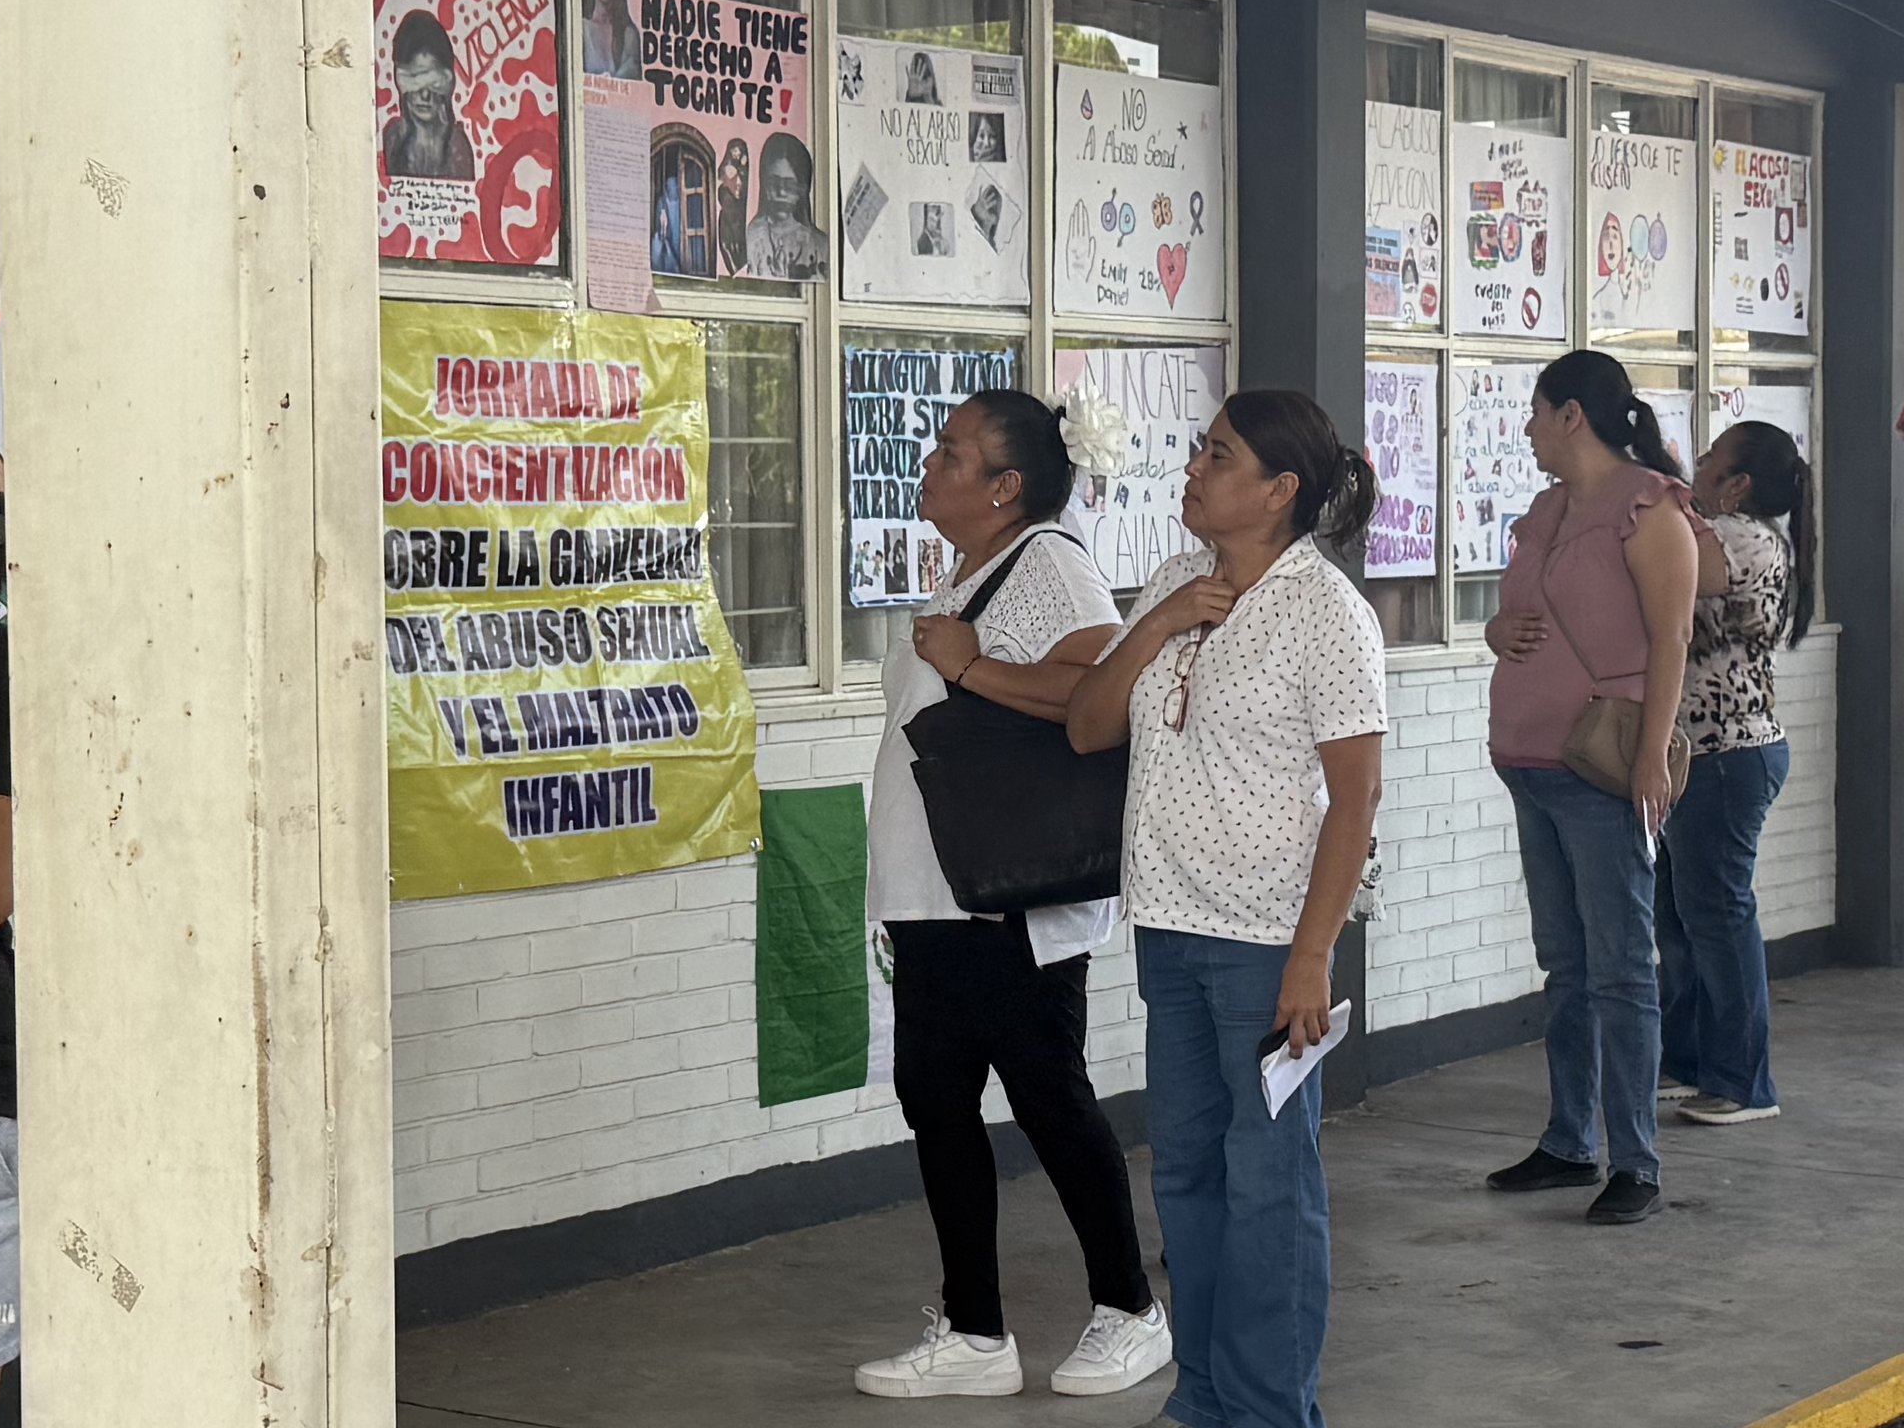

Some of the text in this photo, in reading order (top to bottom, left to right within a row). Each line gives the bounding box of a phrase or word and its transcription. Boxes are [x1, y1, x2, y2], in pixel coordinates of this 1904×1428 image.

[642, 31, 782, 84] DERECHO A
[735, 7, 808, 55] TIENE
[881, 108, 902, 137] NO
[906, 109, 924, 138] AL
[1122, 88, 1146, 131] NO
[1749, 152, 1789, 180] ACOSO
[434, 356, 642, 421] JORNADA DE
[850, 397, 905, 437] DEBE
[382, 438, 686, 503] CONCIENTIZACIÓN
[384, 529, 490, 590] OBRE
[496, 529, 540, 587] LA
[386, 605, 711, 674] DEL ABUSO SEXUAL
[438, 684, 700, 757] Y EL MALTRATO
[504, 766, 657, 838] INFANTIL
